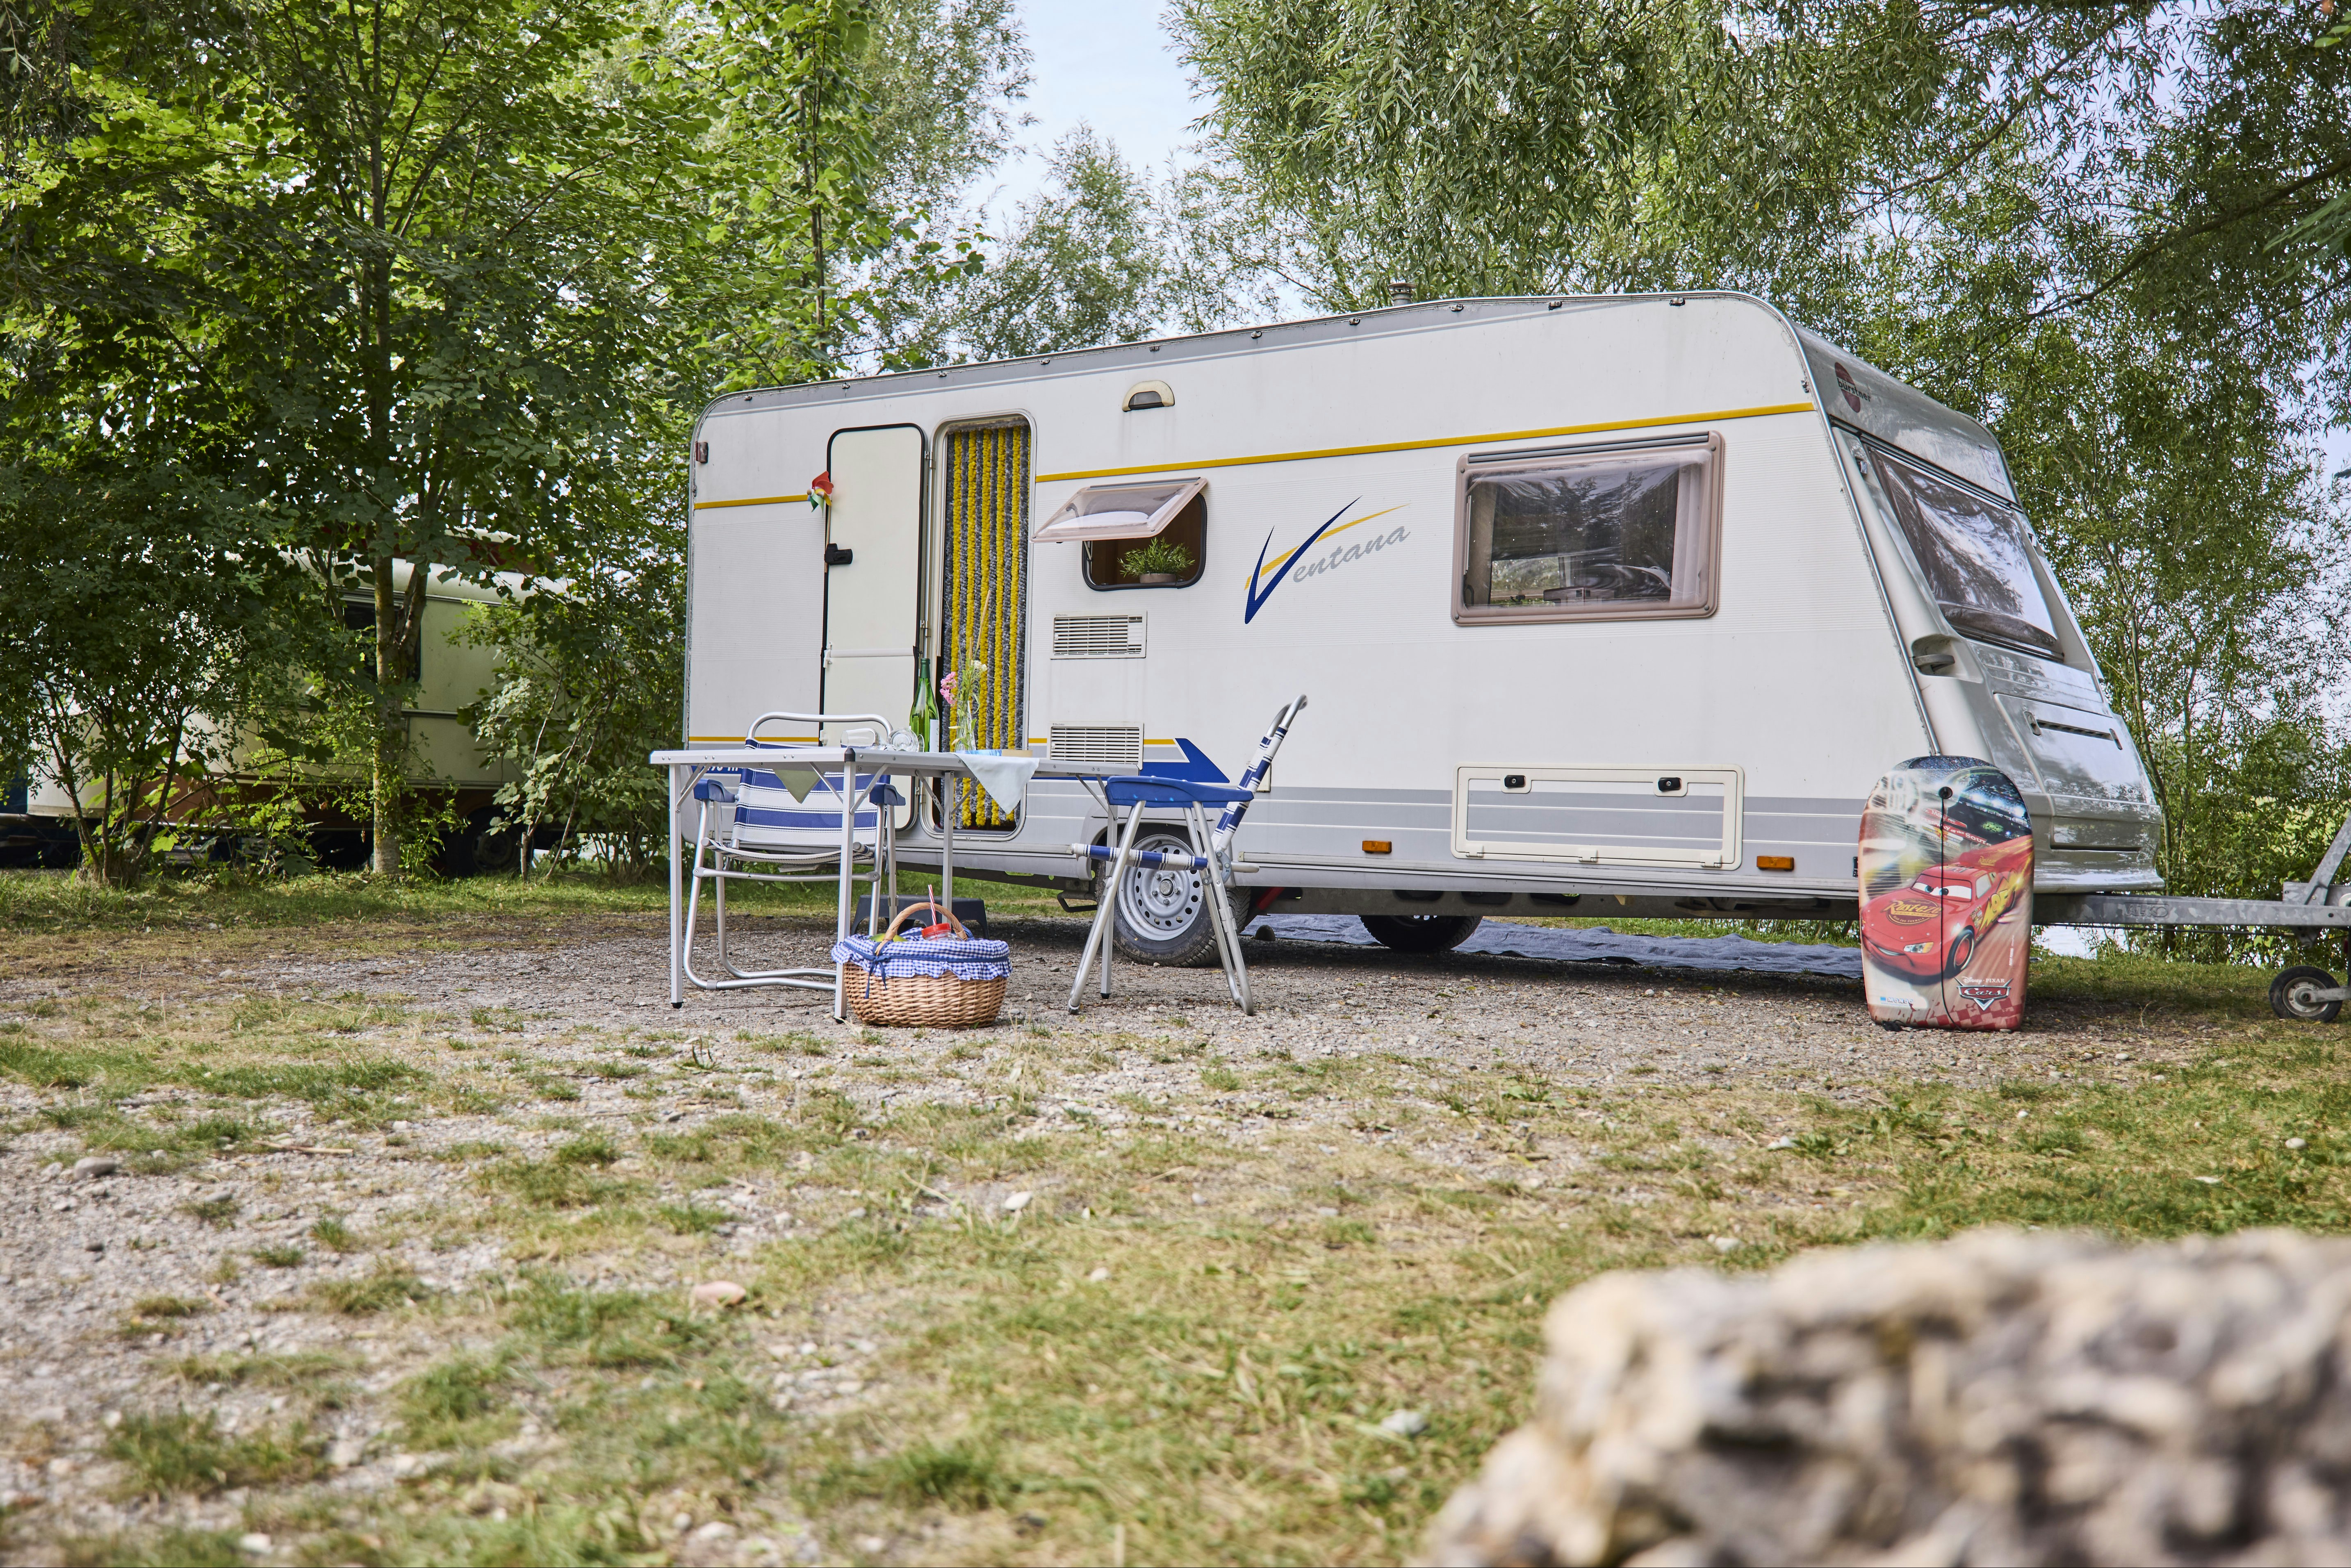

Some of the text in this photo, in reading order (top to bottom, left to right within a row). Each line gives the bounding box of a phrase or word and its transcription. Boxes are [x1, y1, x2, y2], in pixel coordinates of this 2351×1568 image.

[1837, 378, 1871, 402] bürstner
[1244, 495, 1411, 624] Ventana
[1961, 976, 1982, 985] Disney
